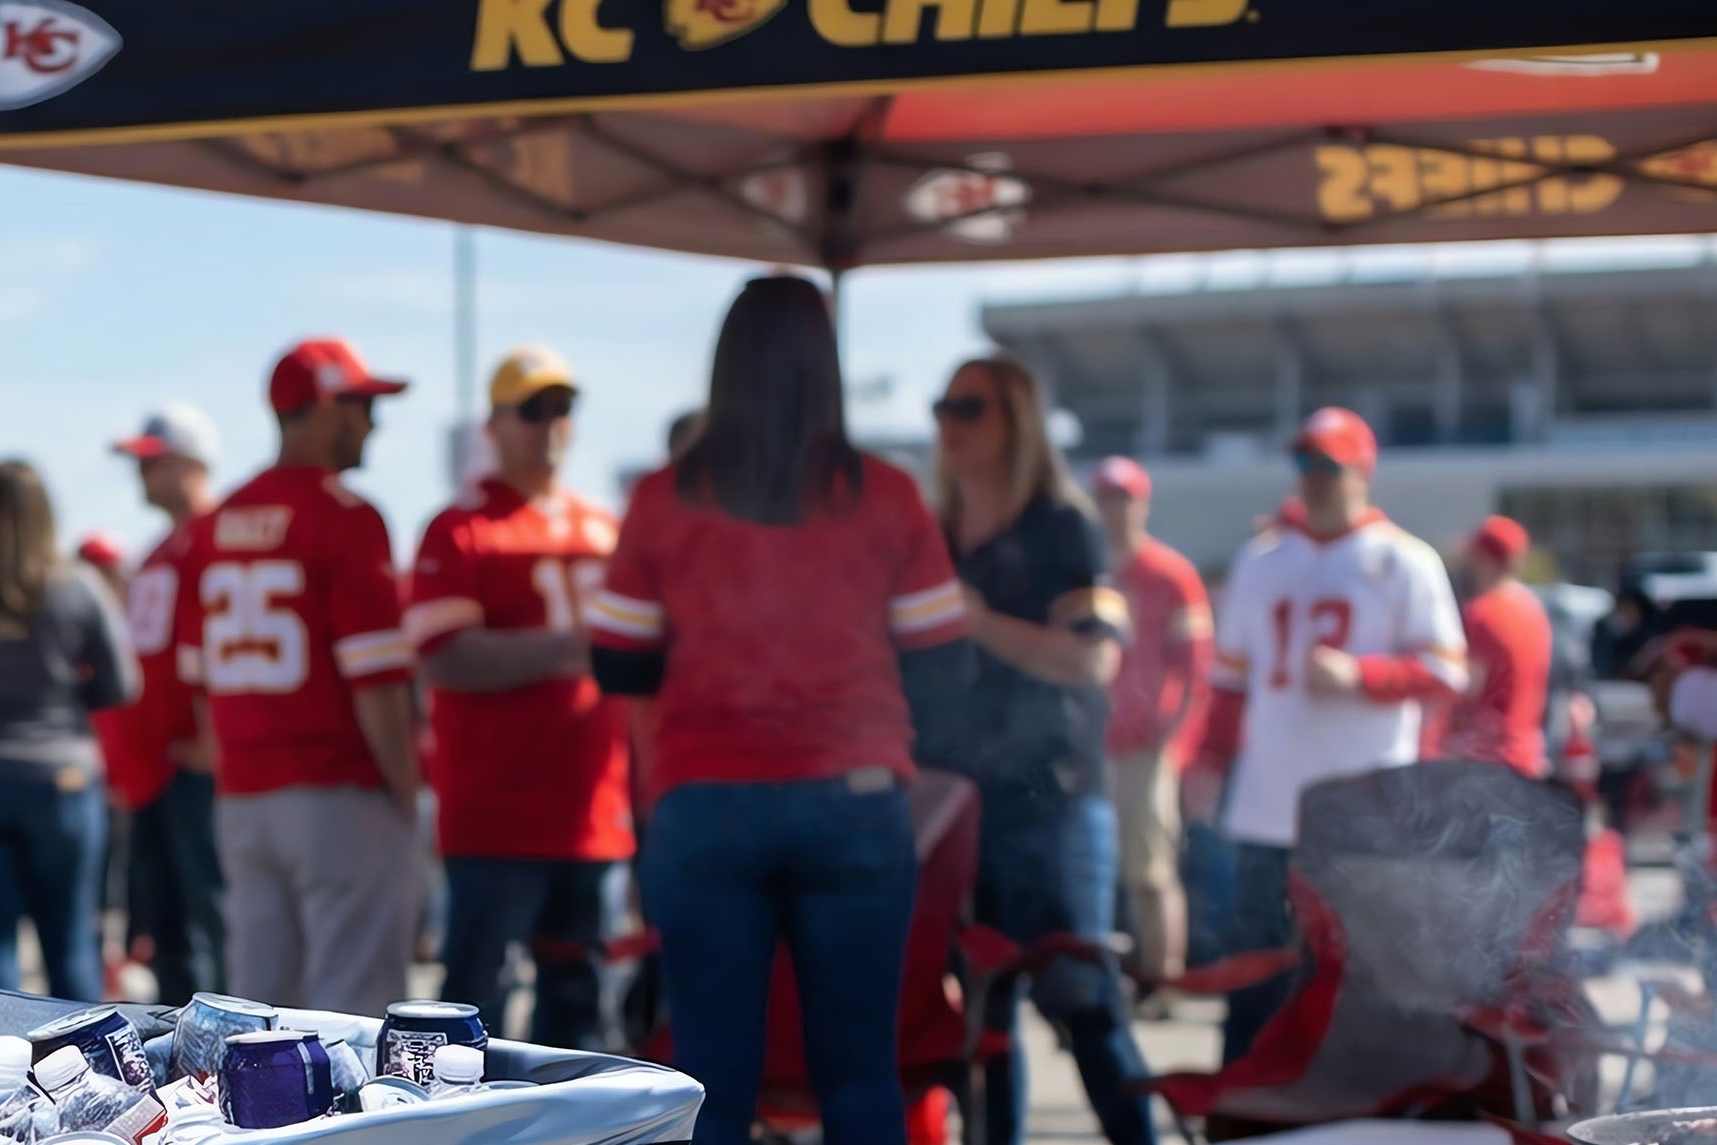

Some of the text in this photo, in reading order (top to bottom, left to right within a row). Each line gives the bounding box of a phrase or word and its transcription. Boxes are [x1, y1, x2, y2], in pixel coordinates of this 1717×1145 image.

[3, 18, 80, 75] KC
[470, 0, 634, 70] KC
[200, 560, 309, 693] 25
